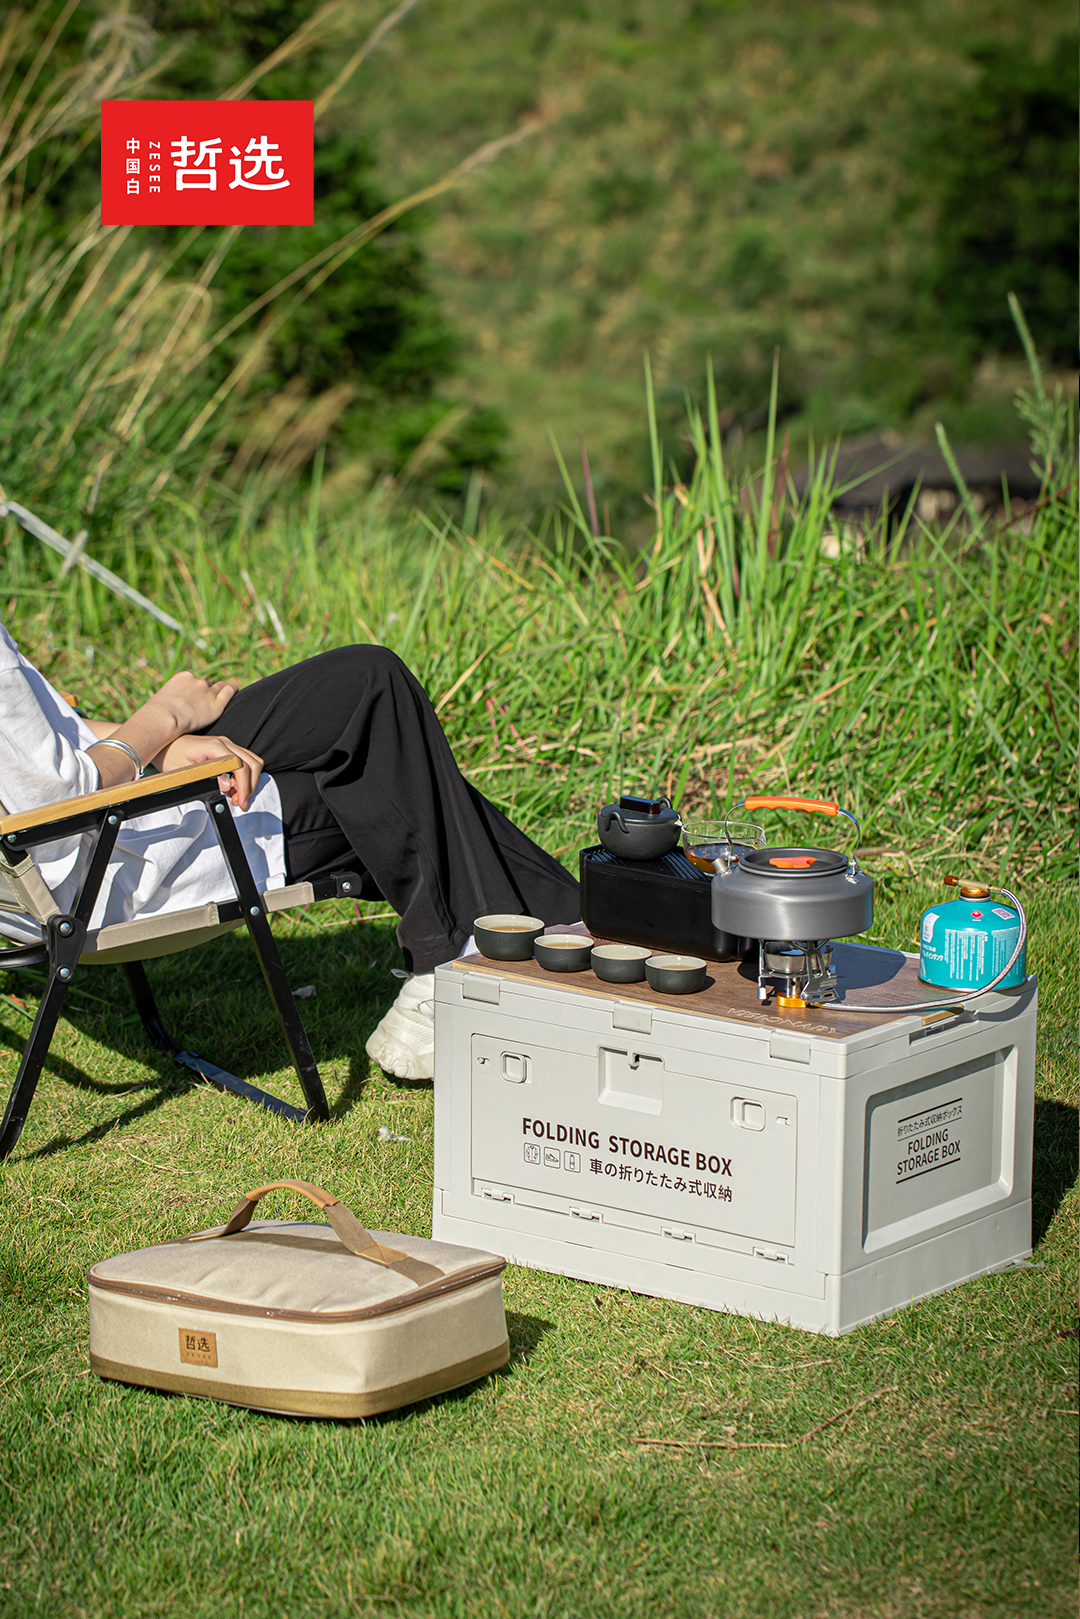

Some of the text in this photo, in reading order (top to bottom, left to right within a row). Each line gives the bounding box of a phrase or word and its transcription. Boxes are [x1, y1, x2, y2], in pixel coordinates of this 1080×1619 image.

[522, 1117, 733, 1177] FOLDING STORAGE BOX
[897, 1139, 961, 1176] STORAGE BOX
[907, 1128, 949, 1156] FOLDING
[589, 1158, 733, 1203] 車の折りたたみ式収納
